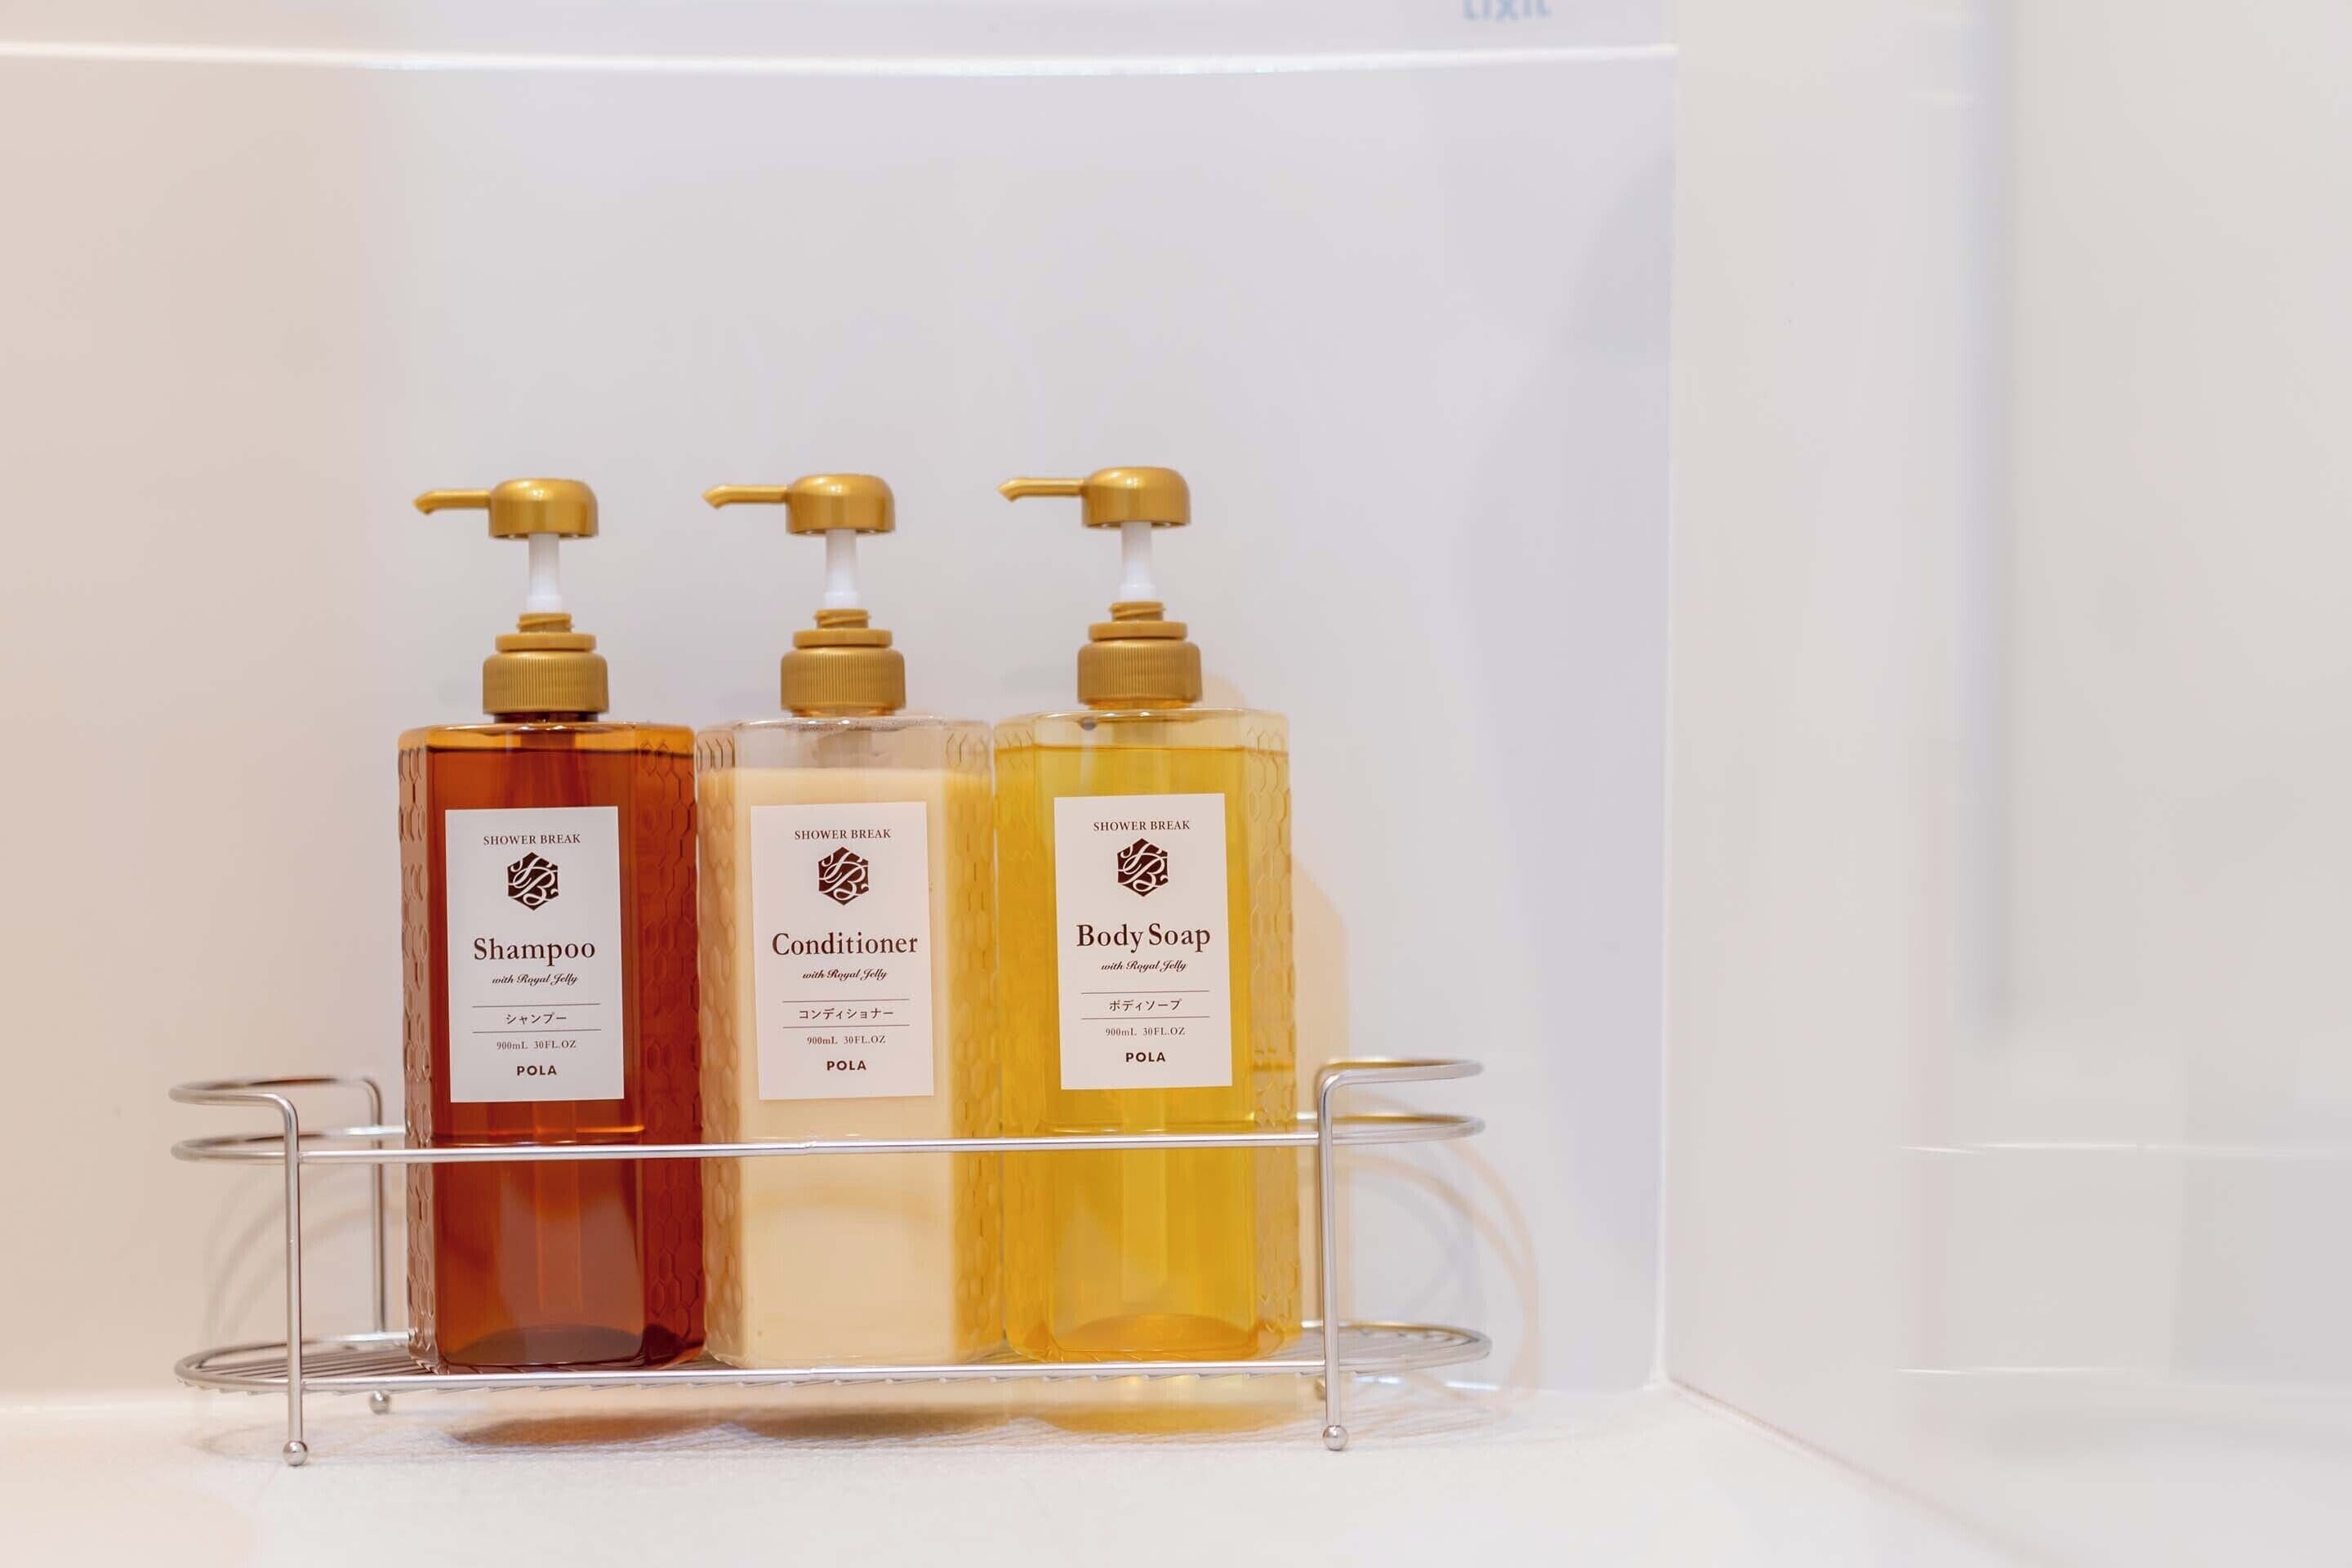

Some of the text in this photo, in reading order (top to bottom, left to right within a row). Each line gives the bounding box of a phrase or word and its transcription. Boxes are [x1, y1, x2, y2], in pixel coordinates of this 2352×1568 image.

[1093, 820, 1191, 832] SHOWER BREAK
[483, 833, 581, 846] SHOWER BREAK
[794, 828, 892, 840] SHOWER BREAK
[772, 931, 919, 956] Conditioner
[1076, 922, 1211, 955] Body Soap
[473, 937, 596, 968] Shampoo
[1101, 959, 1187, 973] with Royal Jelly
[492, 972, 579, 987] with Royal Jelly
[802, 967, 888, 982] with Royal Jelly
[1108, 998, 1183, 1013] ボディソープ
[505, 1011, 568, 1026] シャンプー
[798, 1007, 895, 1021] コンディショナー
[1105, 1027, 1187, 1037] 900mL 30FL.OZ
[496, 1039, 577, 1051] 900mL 30FL.OZ
[806, 1035, 887, 1046] 900mL 30FL.OZ
[1125, 1051, 1166, 1063] POLA
[516, 1064, 558, 1077] POLA
[826, 1059, 867, 1072] POLA
